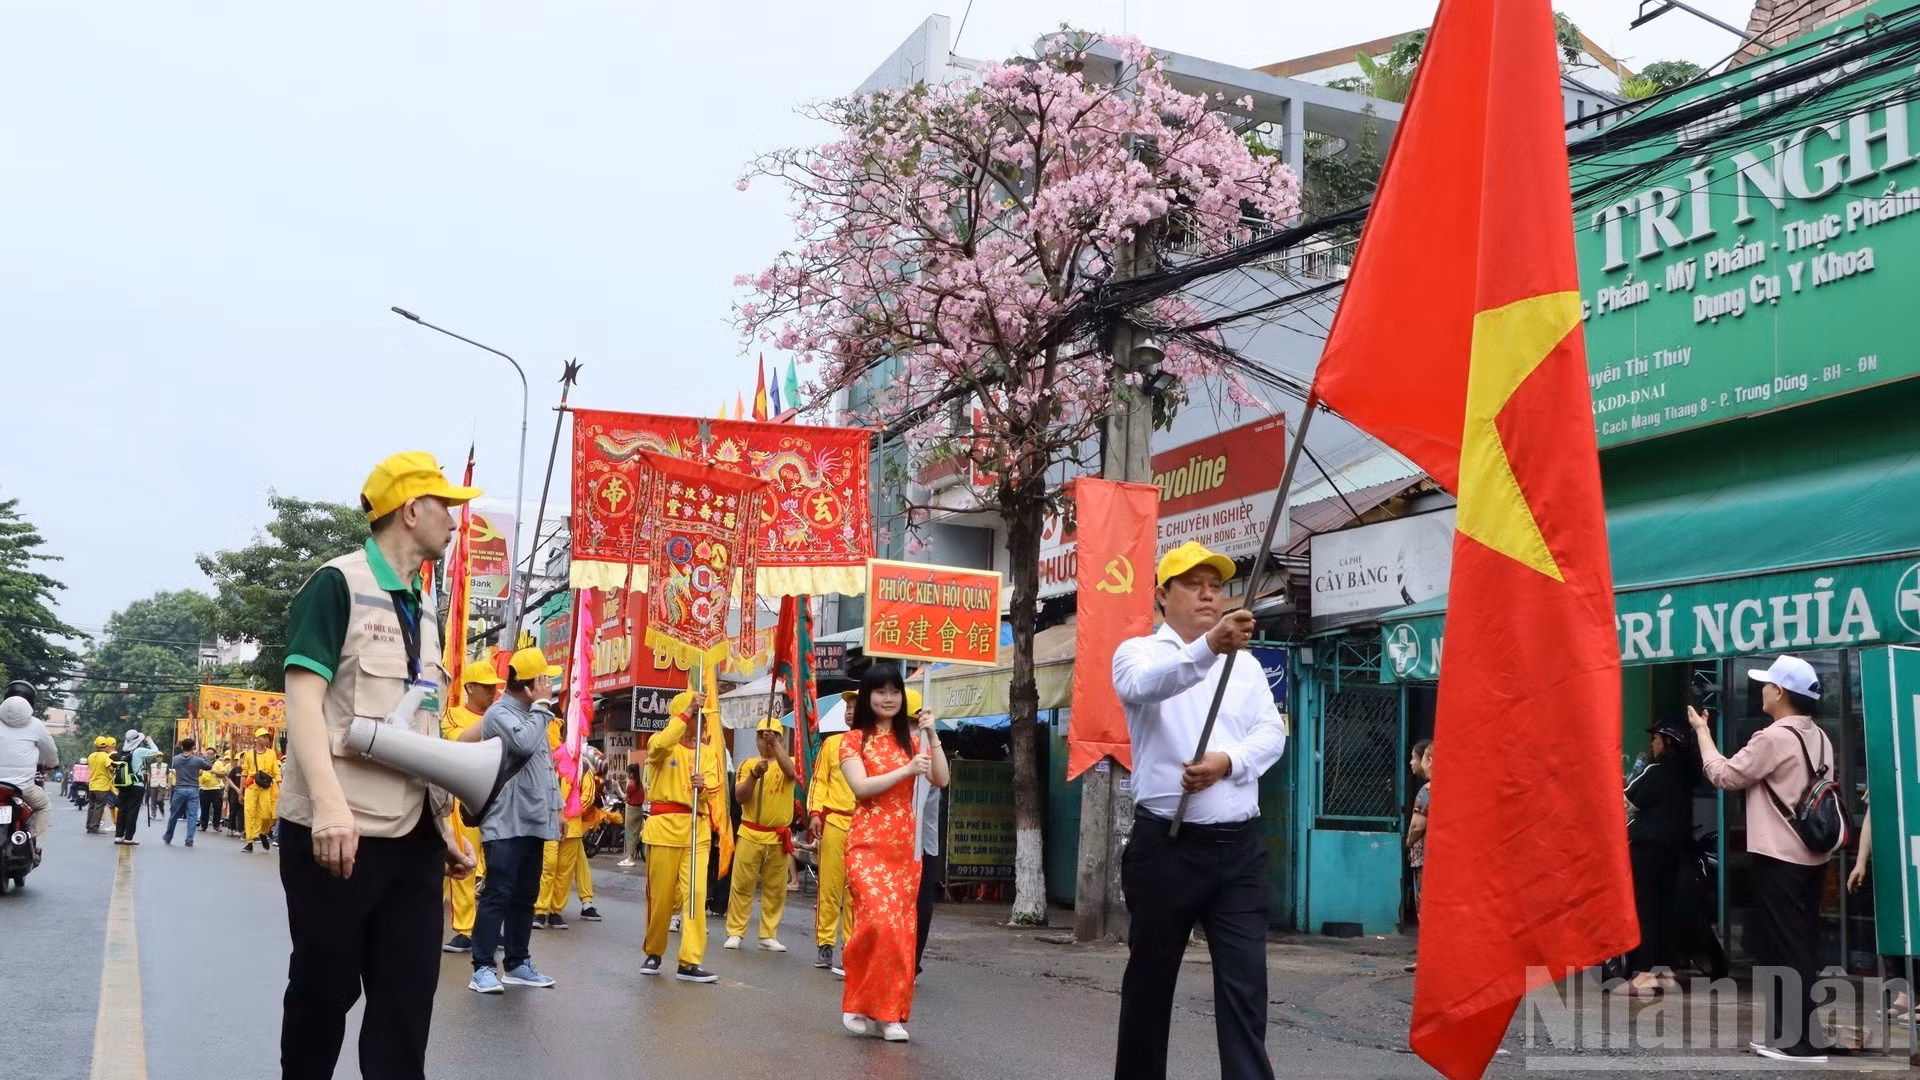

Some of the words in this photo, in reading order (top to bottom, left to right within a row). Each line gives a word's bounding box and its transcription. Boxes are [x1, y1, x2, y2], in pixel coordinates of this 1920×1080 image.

[1592, 148, 1716, 273] TRÍ
[1731, 90, 1920, 225] NGH
[1597, 273, 1650, 316] Phẩm
[1666, 256, 1698, 293] Mỹ
[1705, 234, 1766, 280] Phẩm
[1783, 213, 1842, 253] Thực
[1694, 287, 1746, 325] Dụng
[1750, 273, 1782, 305] Cụ
[1788, 260, 1805, 292] Y
[1812, 246, 1875, 288] Khoa
[1625, 354, 1648, 378] Thị
[1602, 417, 1628, 436] Cách
[1631, 411, 1661, 430] Mạng
[1664, 401, 1698, 421] Tháng
[1700, 397, 1707, 412] 8
[1734, 382, 1772, 404] Trung
[1774, 372, 1809, 395] Dũng
[1823, 363, 1841, 383] BH
[1858, 354, 1878, 374] ĐN
[1151, 454, 1228, 503] avoline
[1166, 512, 1210, 537] CHUYÊN
[878, 574, 914, 603] PHƯỚC
[916, 571, 940, 606] KIẾN
[942, 579, 960, 611] HỘI
[963, 582, 992, 612] QUÁN
[1315, 569, 1345, 593] CÂY
[1348, 564, 1388, 588] BÀNG
[872, 611, 994, 655] 福建會館
[1615, 593, 1675, 660] RÍ
[1692, 577, 1880, 655] NGHĨA
[609, 735, 633, 747] TÂM
